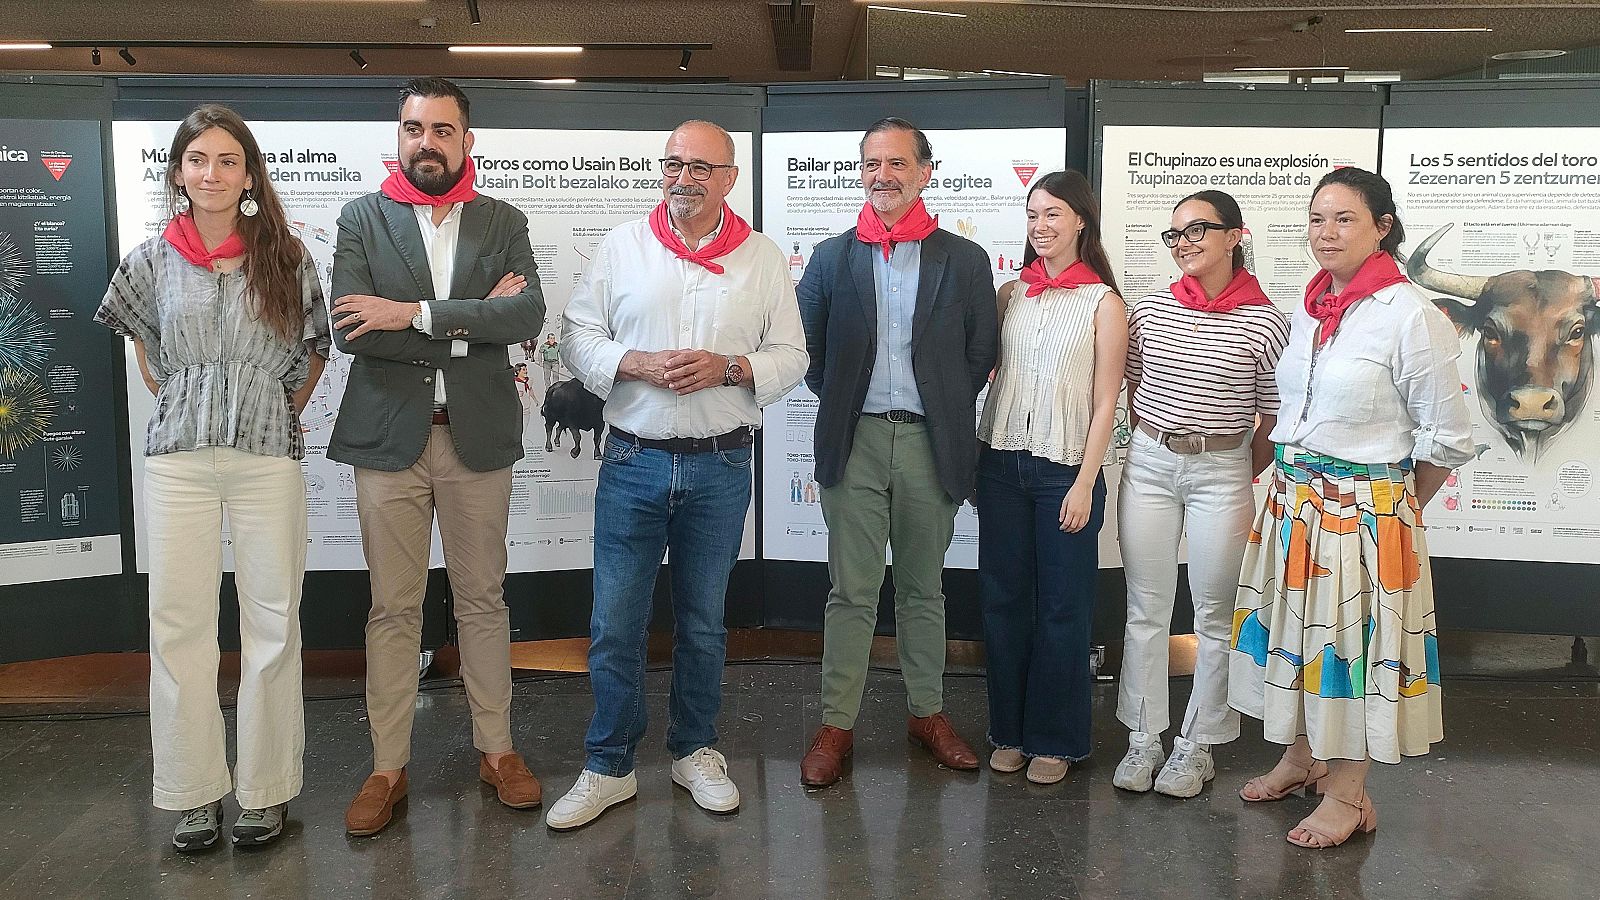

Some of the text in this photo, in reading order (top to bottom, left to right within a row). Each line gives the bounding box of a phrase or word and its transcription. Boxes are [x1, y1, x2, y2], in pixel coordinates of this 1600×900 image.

[0, 146, 28, 161] ica
[141, 148, 170, 163] Mú
[280, 149, 294, 163] al
[297, 149, 337, 163] alma
[1410, 153, 1598, 167] Los 5 sentidos del toro
[472, 155, 652, 171] Toros como Usain Bolt
[787, 157, 831, 172] Bailar
[1128, 152, 1142, 167] El
[1144, 152, 1217, 171] Chupinazo
[1219, 156, 1235, 167] es
[1237, 156, 1262, 168] una
[1264, 153, 1329, 171] explosión
[269, 167, 300, 182] den
[304, 167, 362, 182] musika
[475, 173, 519, 189] Usain
[522, 174, 556, 189] Bolt
[559, 174, 629, 189] bezalako
[1127, 170, 1311, 189] Txupinazoa eztanda bat da
[1408, 171, 1496, 185] Zezenaren
[1499, 171, 1511, 185] 5
[787, 175, 806, 189] Ez
[942, 173, 993, 192] egitea
